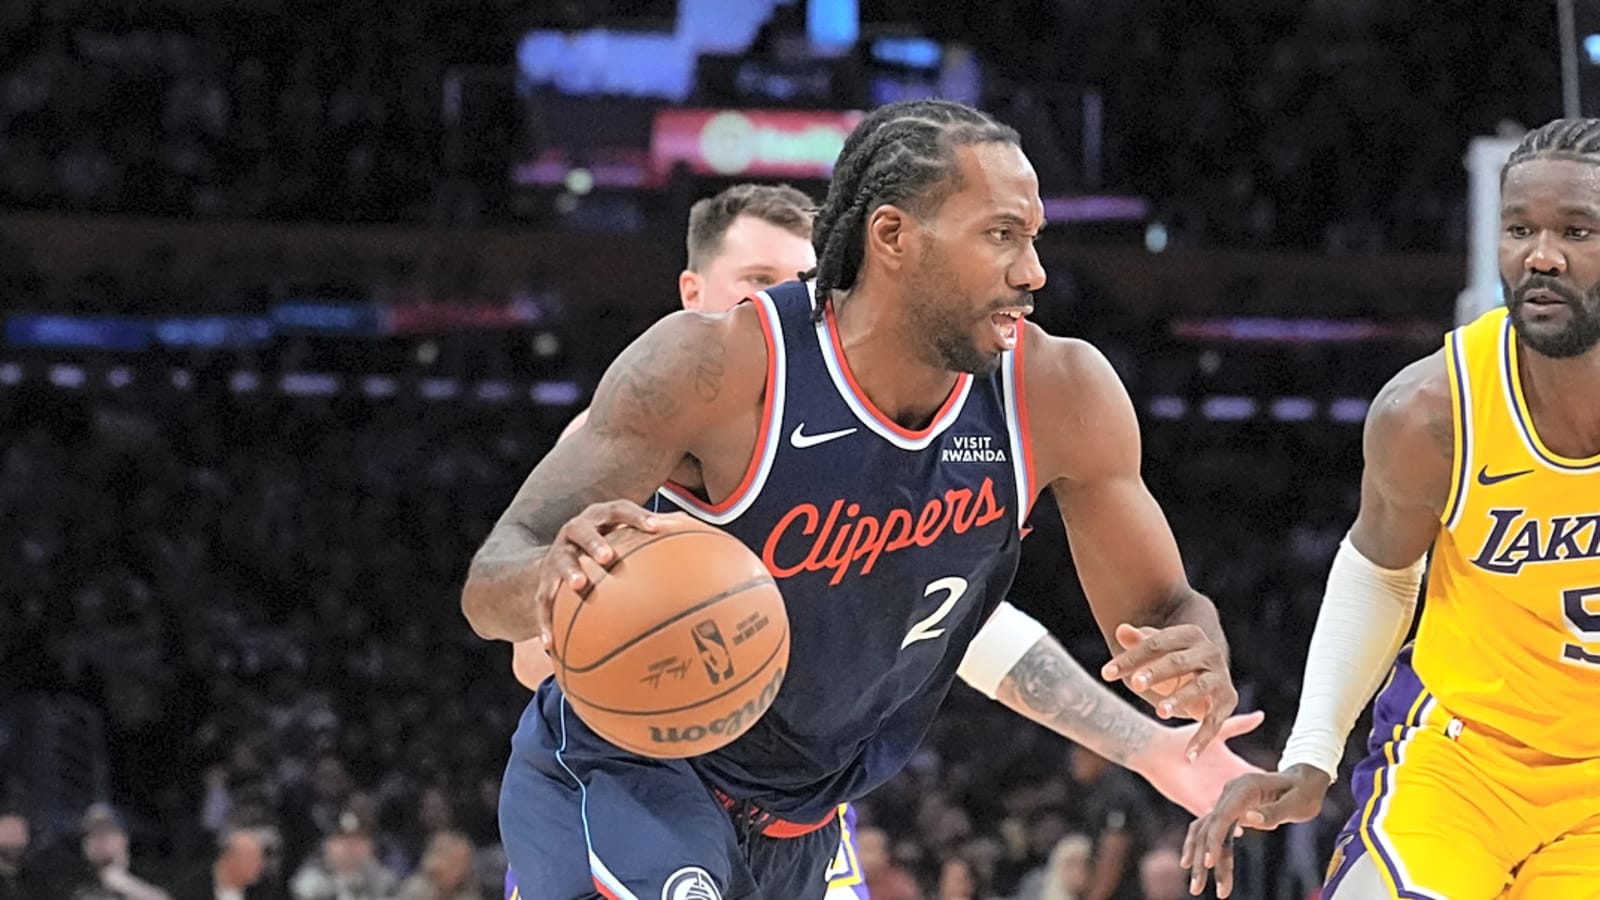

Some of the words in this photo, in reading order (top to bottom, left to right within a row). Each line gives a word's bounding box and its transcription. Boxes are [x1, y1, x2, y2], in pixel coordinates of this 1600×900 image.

[942, 449, 1006, 462] RWANDA
[953, 436, 991, 449] VISIT
[762, 476, 1005, 586] Clippers
[900, 577, 968, 650] 2
